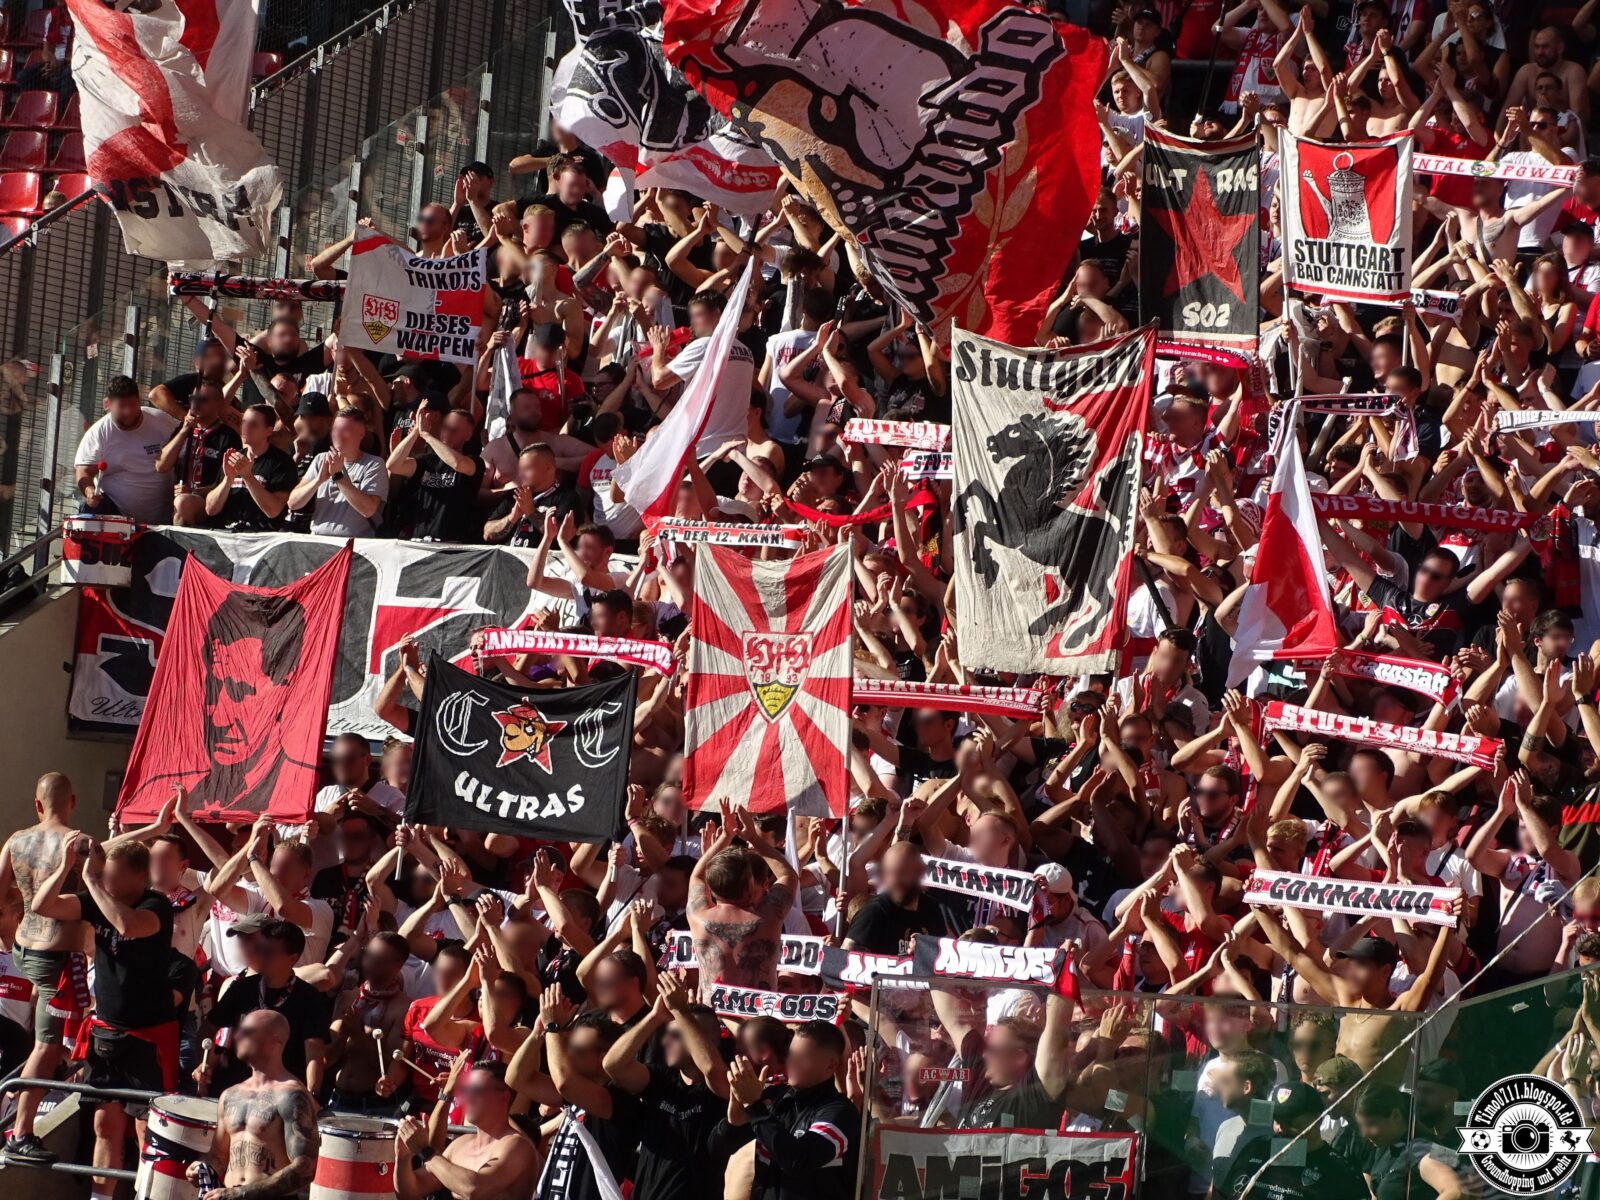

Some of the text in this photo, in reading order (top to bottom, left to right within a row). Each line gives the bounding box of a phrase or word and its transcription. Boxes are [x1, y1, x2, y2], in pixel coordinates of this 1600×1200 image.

[1502, 165, 1577, 181] POWER
[1295, 239, 1405, 272] STUTTGART
[405, 268, 481, 291] TRIKOTS
[1297, 263, 1405, 290] BAD CANNSTATT
[405, 311, 471, 335] DIESES
[397, 330, 475, 359] WAPPEN
[956, 339, 1142, 398] Stuttgart
[1312, 496, 1528, 528] VfB STUTTGART
[658, 529, 785, 546] IST DER 12. MANN!
[485, 630, 599, 654] ANNSTATTER
[760, 672, 798, 684] 18 93
[969, 685, 1043, 705] KURVE
[454, 770, 585, 821] ULTRAS
[1269, 876, 1435, 916] COMMANDO
